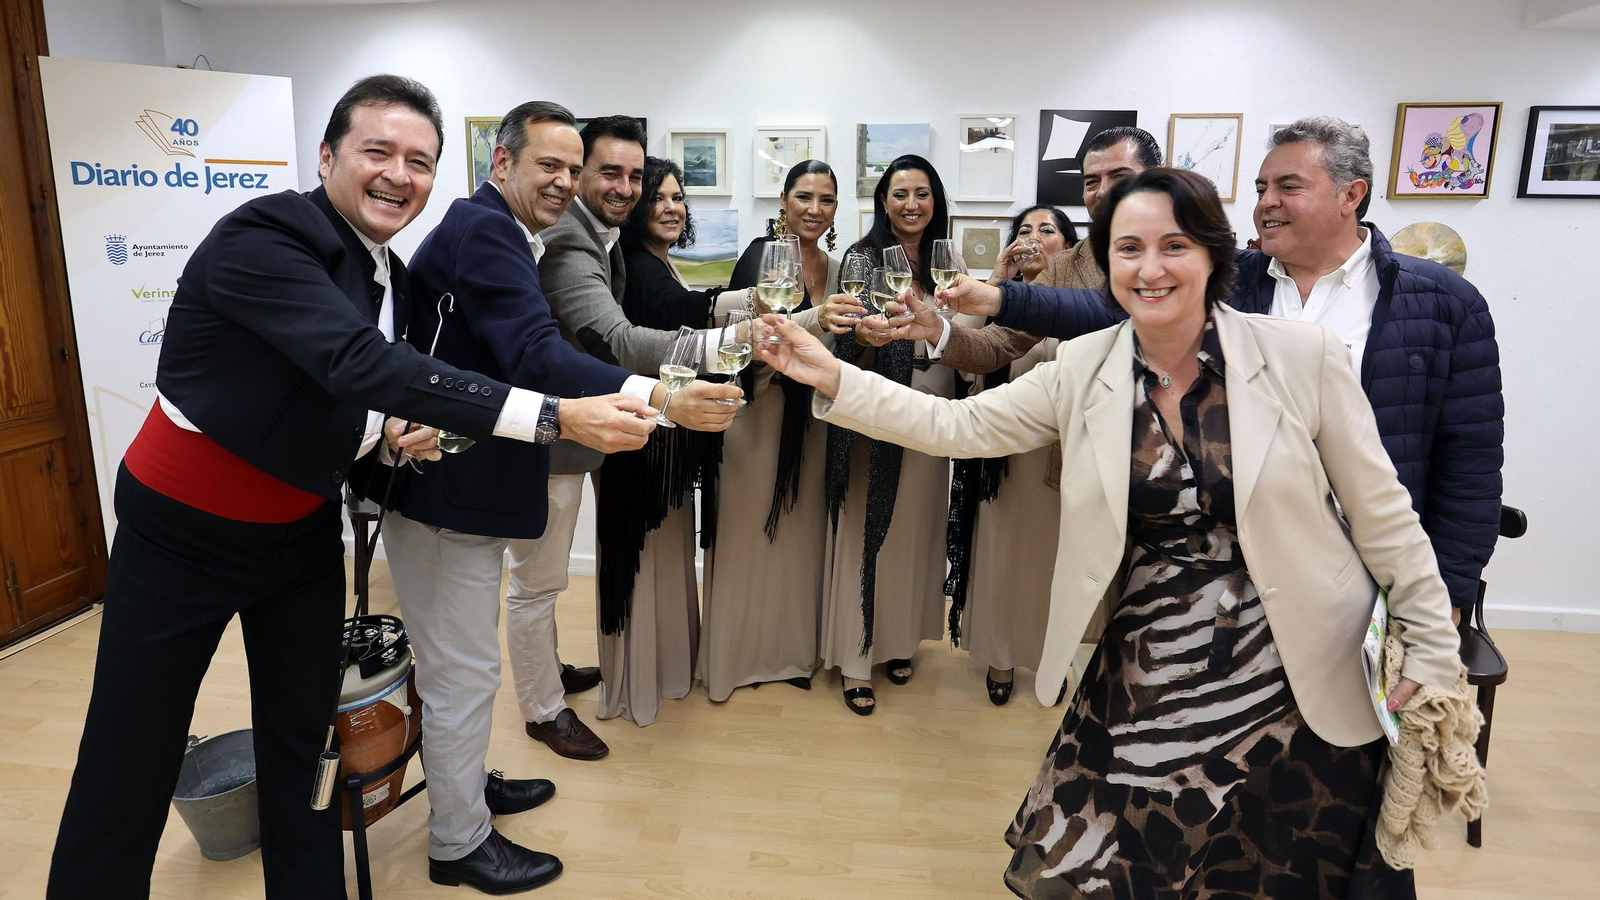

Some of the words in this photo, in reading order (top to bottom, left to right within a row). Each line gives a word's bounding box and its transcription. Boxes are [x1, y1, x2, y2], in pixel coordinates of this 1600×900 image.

[171, 118, 199, 137] 40
[172, 138, 200, 147] AÑOS
[70, 161, 158, 187] Diario
[164, 162, 199, 188] de
[204, 165, 269, 195] Jerez
[132, 243, 189, 252] Ayuntamiento
[145, 251, 166, 259] Jerez
